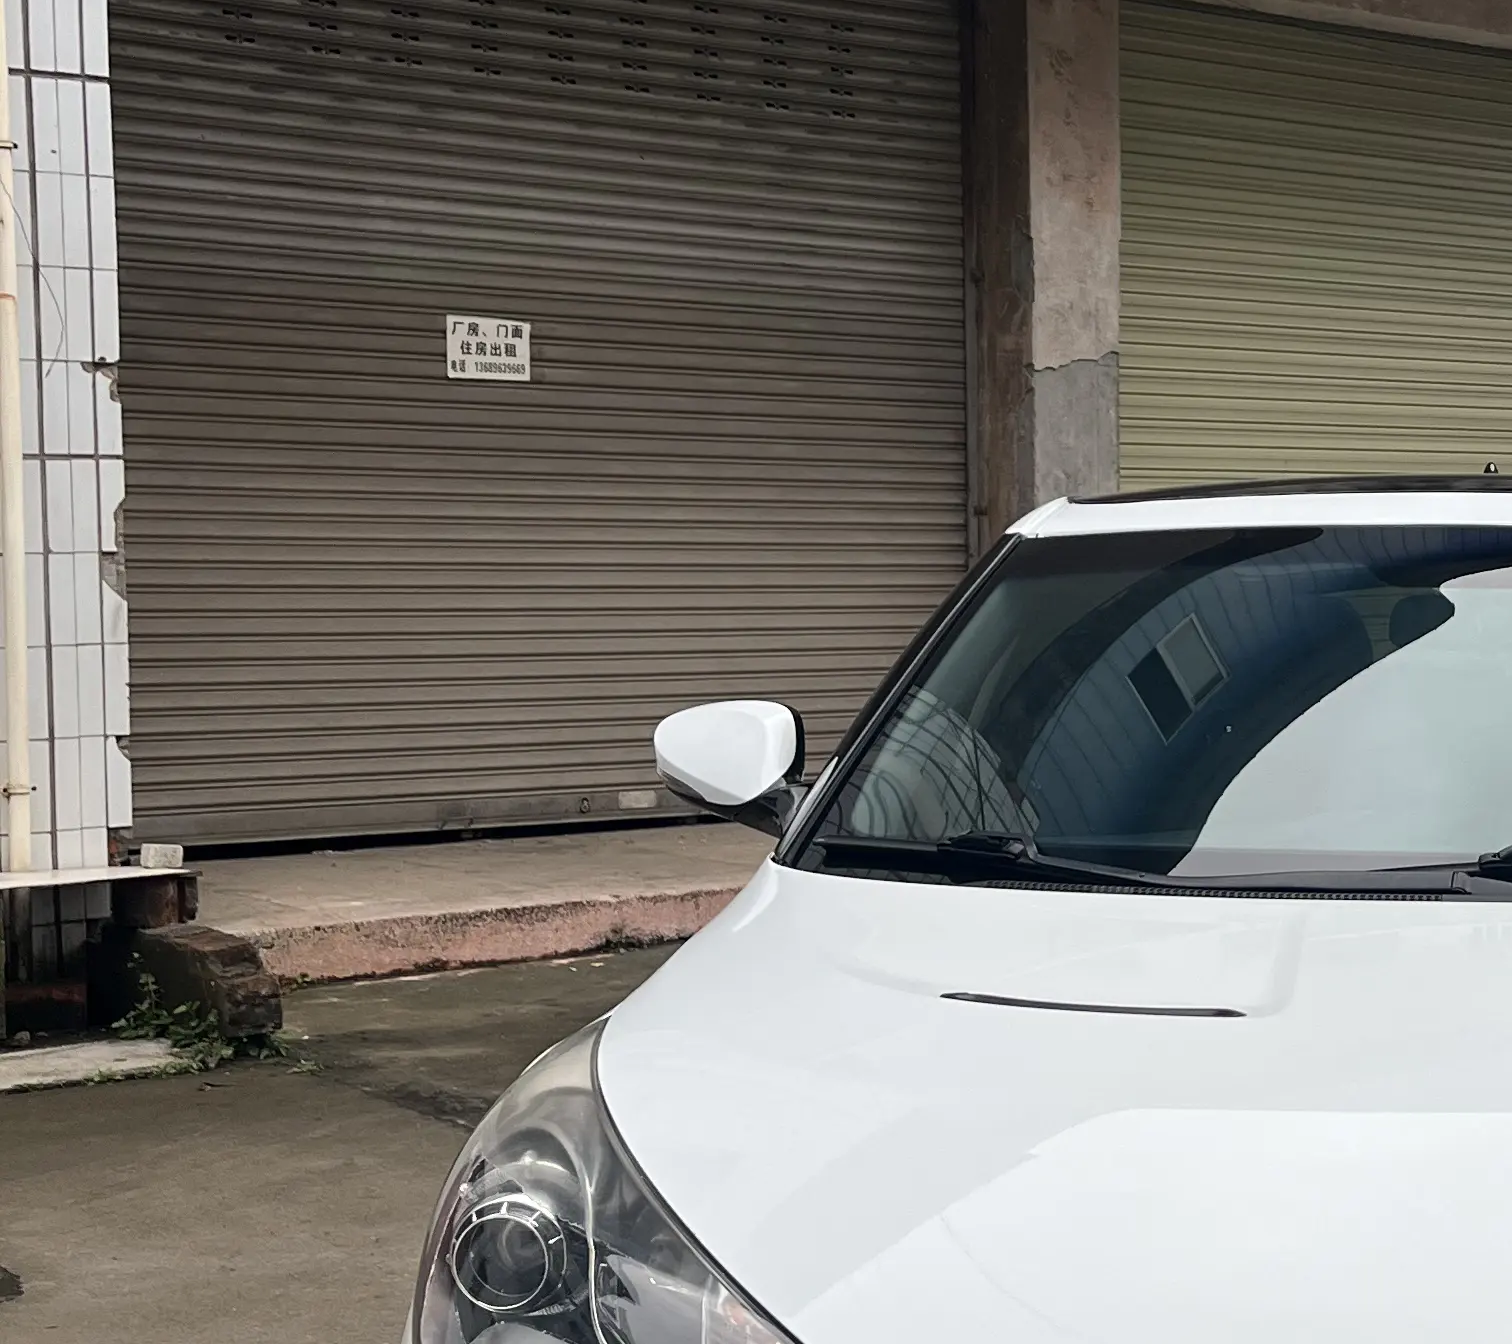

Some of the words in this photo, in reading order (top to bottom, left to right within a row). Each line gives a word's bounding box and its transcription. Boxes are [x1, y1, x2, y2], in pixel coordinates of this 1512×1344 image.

[451, 321, 523, 339] 厂房、门面
[460, 340, 517, 358] 住房出租
